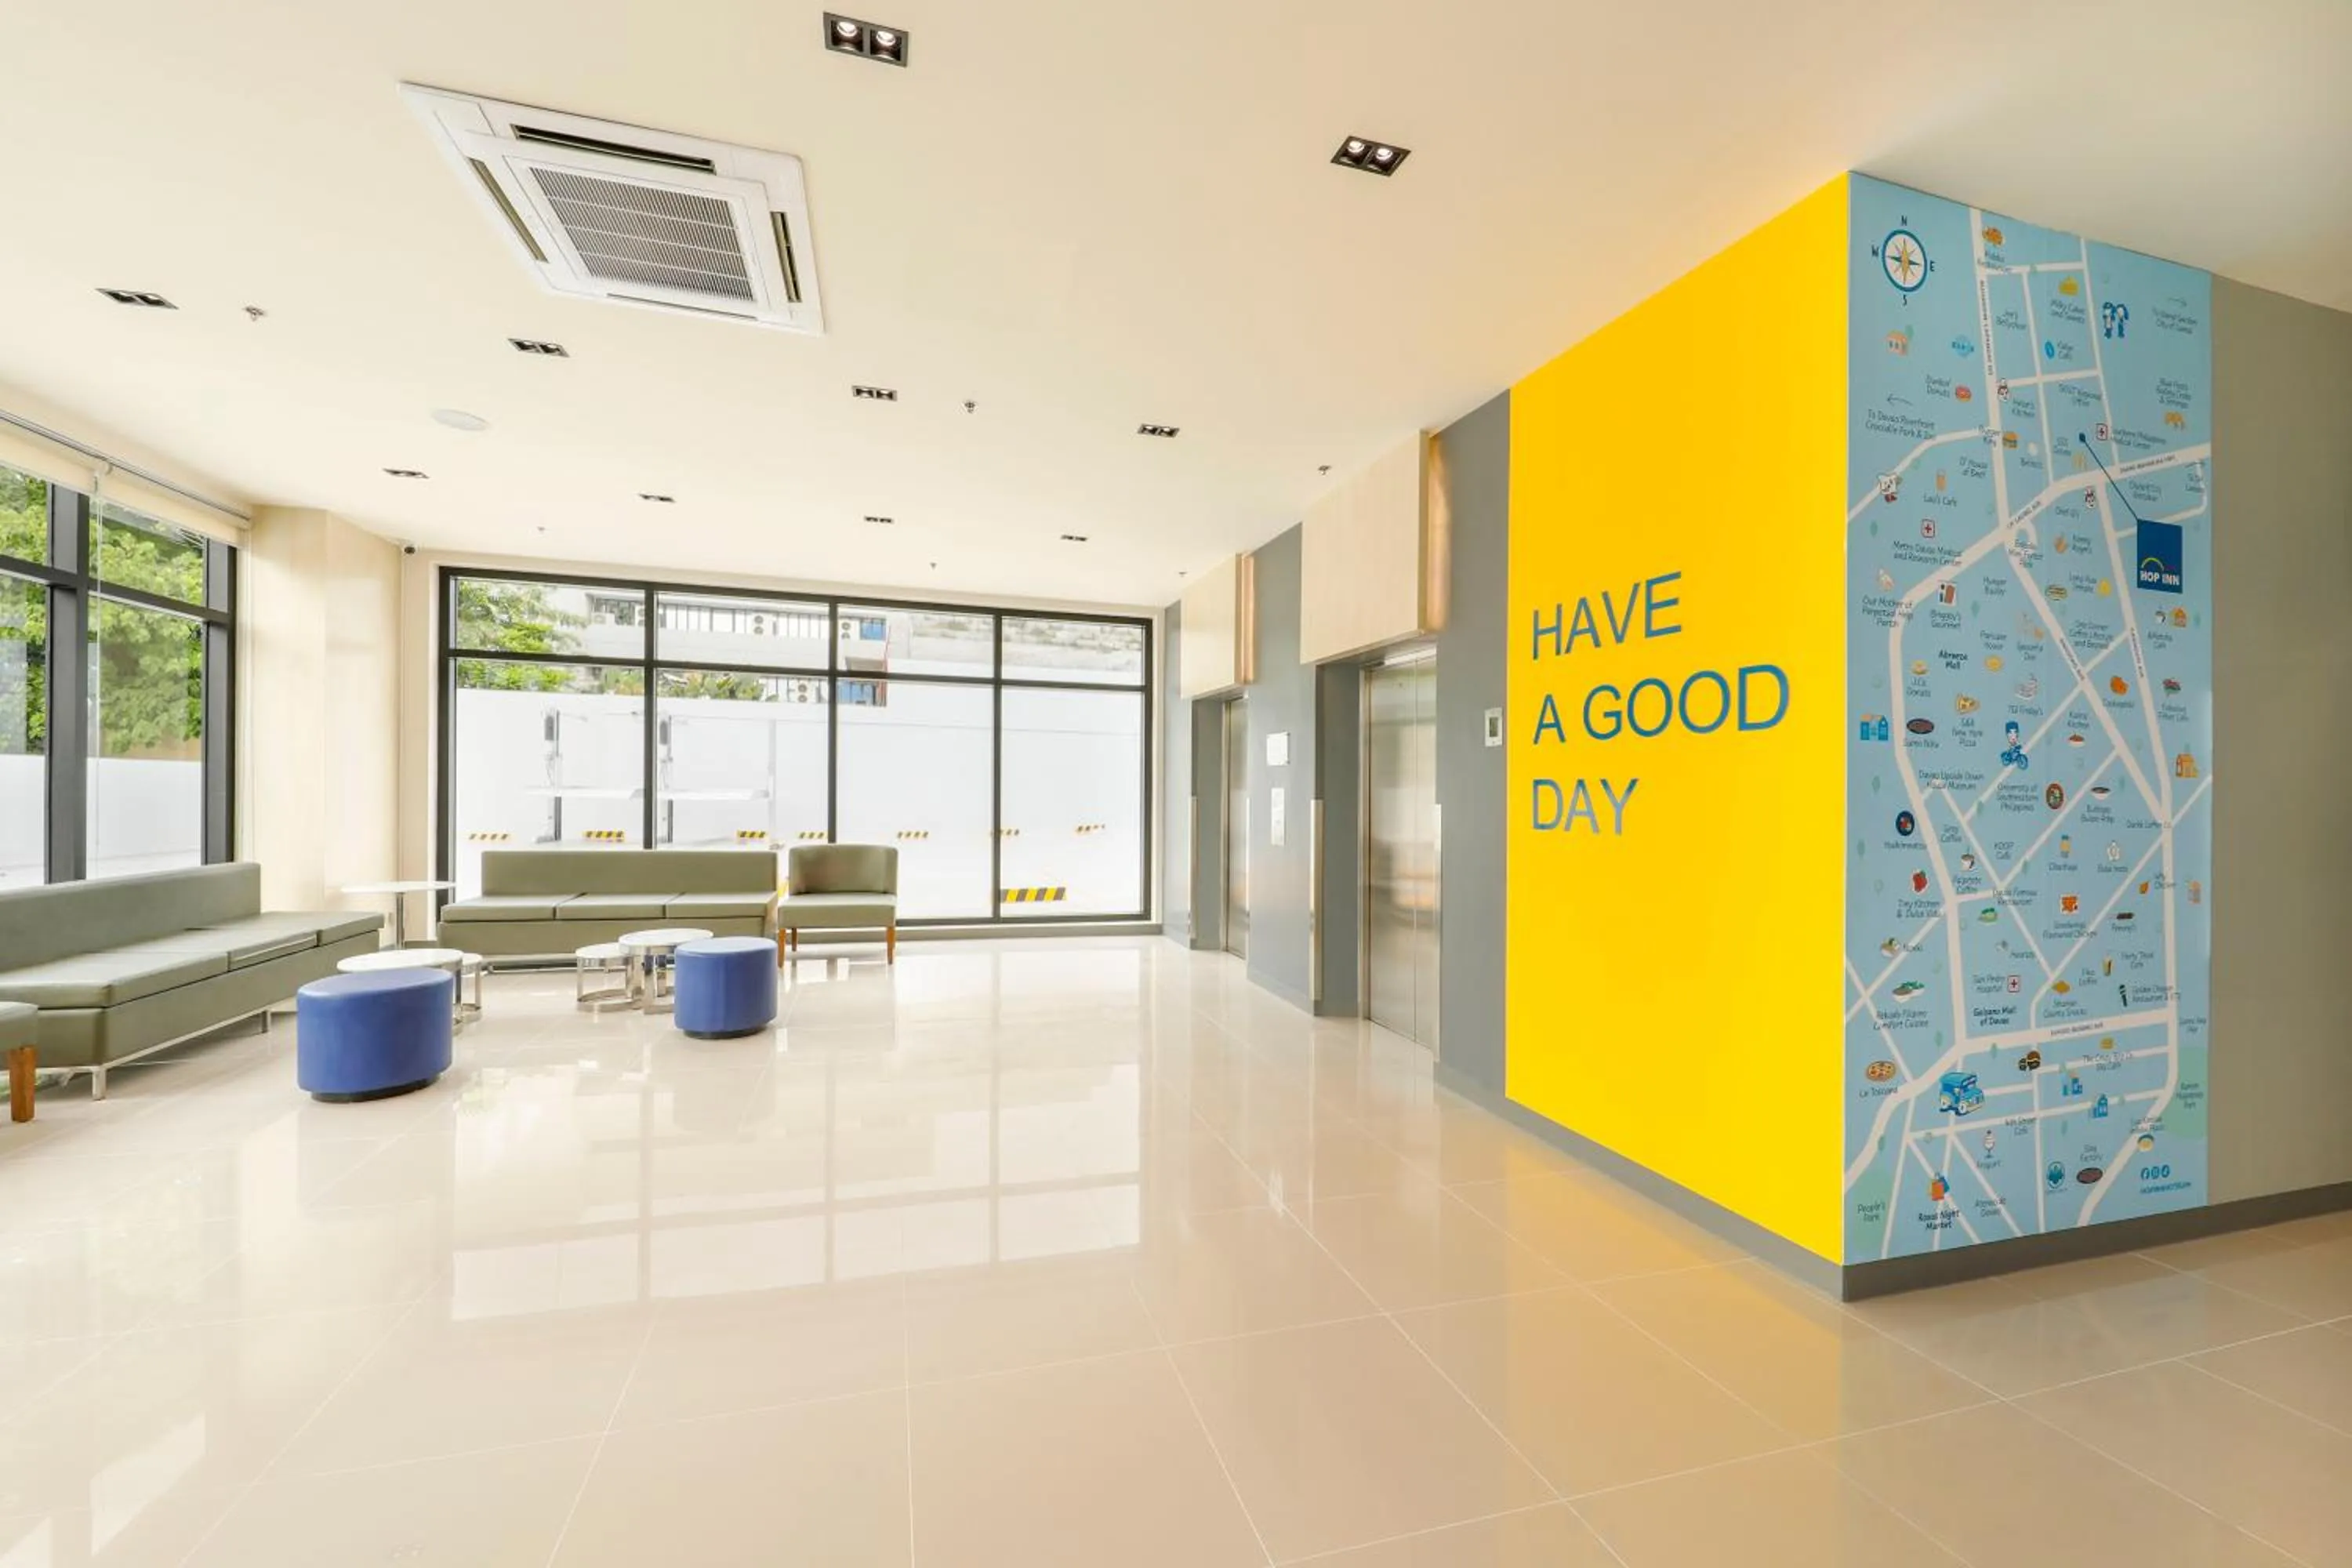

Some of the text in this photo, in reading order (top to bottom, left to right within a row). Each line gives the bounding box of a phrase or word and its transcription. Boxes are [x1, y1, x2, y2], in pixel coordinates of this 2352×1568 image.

[1901, 216, 1907, 226] N
[1872, 245, 1879, 256] W
[1929, 261, 1935, 271] E
[1903, 295, 1907, 306] S
[1908, 554, 1938, 564] Research
[2140, 571, 2180, 586] HOP INN
[1863, 595, 1879, 606] Our
[1533, 571, 1682, 661] HAVE
[1945, 661, 1961, 670] Mall
[1533, 664, 1790, 746] A GOOD
[1533, 779, 1639, 837] DAY
